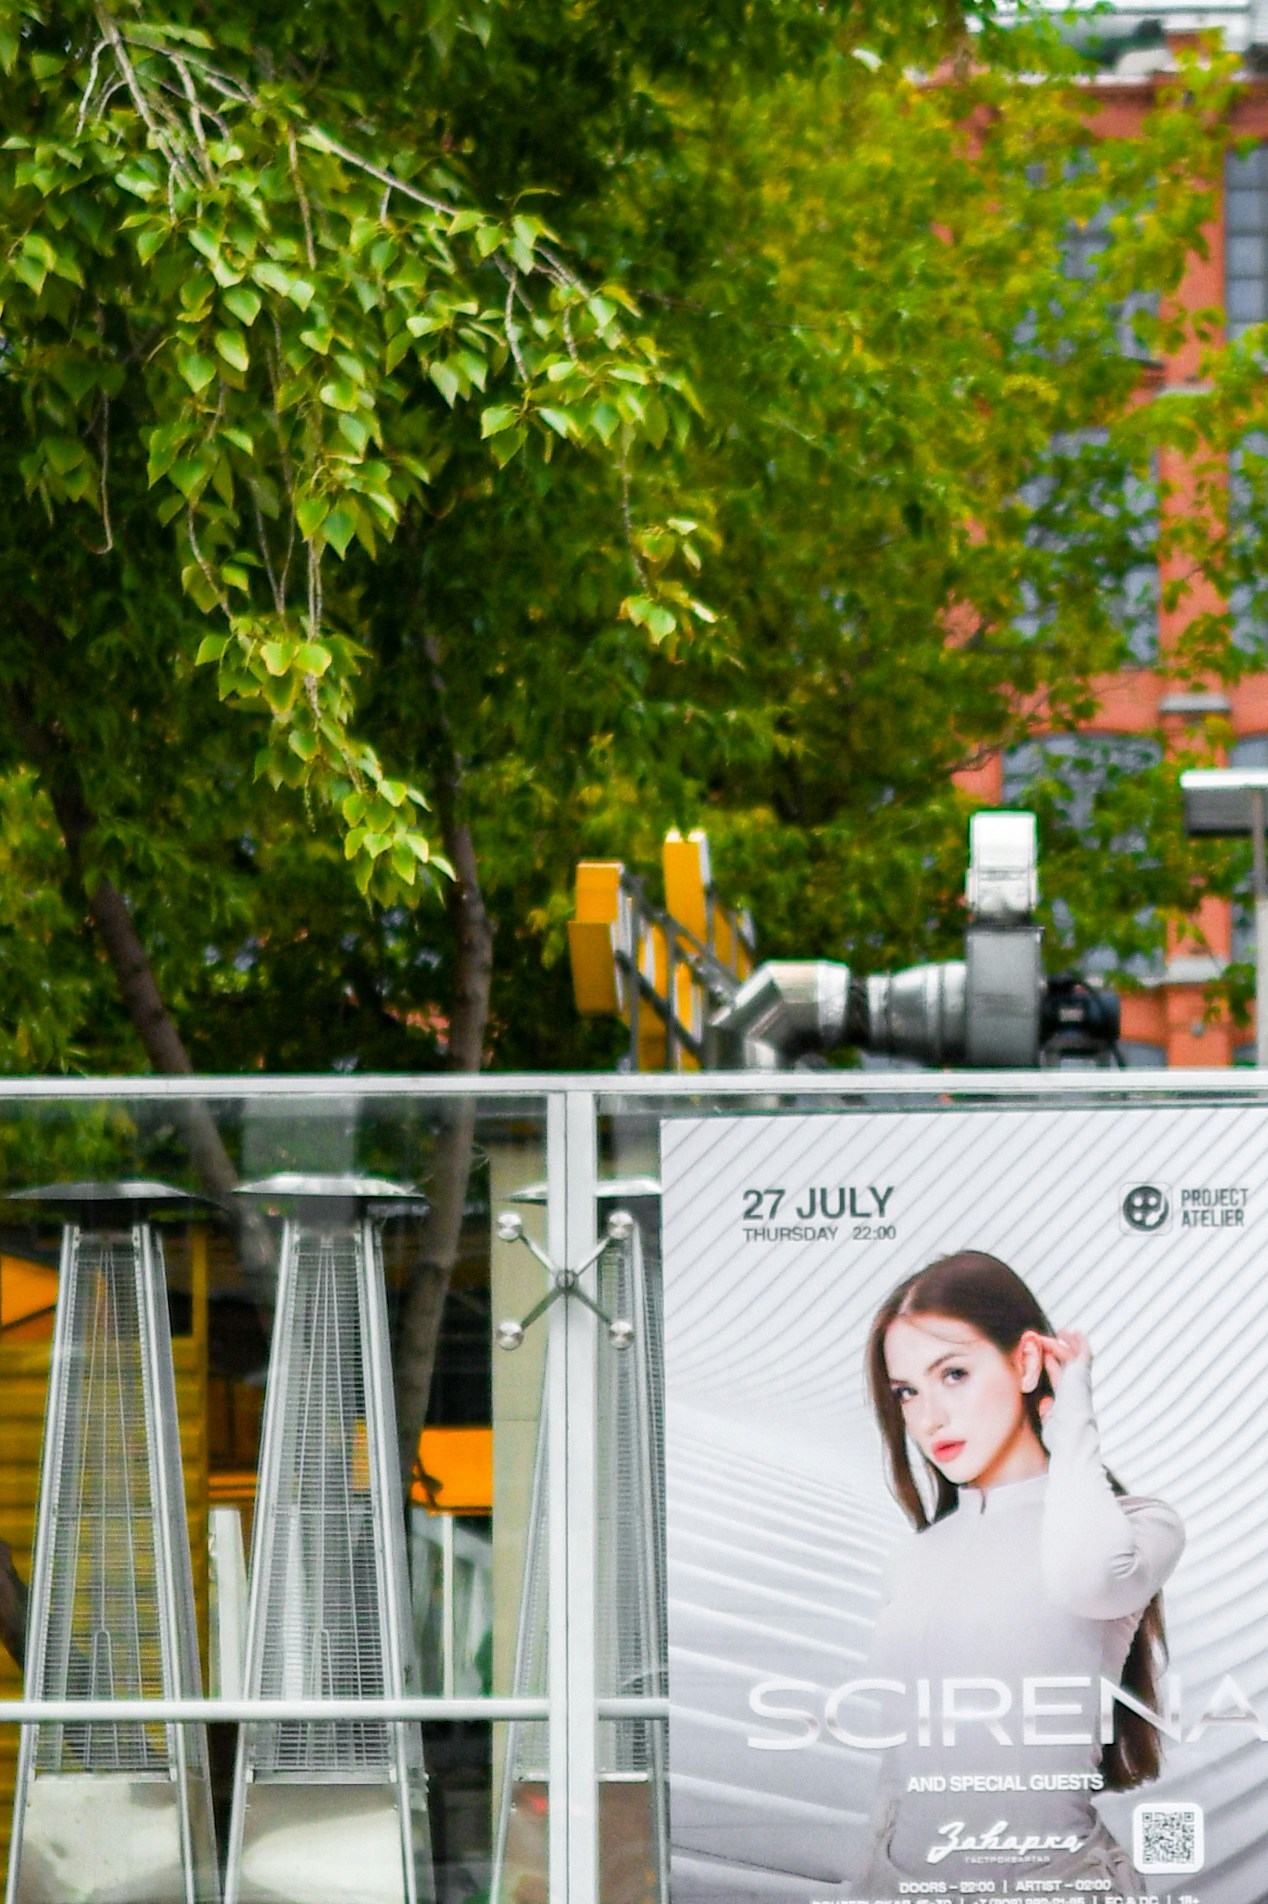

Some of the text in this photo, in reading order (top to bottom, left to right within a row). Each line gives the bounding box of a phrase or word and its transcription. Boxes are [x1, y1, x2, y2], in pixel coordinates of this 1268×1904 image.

[743, 1186, 895, 1220] 27 JULY
[1181, 1188, 1249, 1207] PROJECT
[1181, 1209, 1244, 1227] ATELIER
[743, 1225, 896, 1242] THURSDAY 22:00
[907, 1773, 1104, 1792] AND SPECIAL GUESTS
[899, 1882, 947, 1894] DOORS
[960, 1881, 995, 1893] 22:00
[1015, 1880, 1062, 1892] ARTIST
